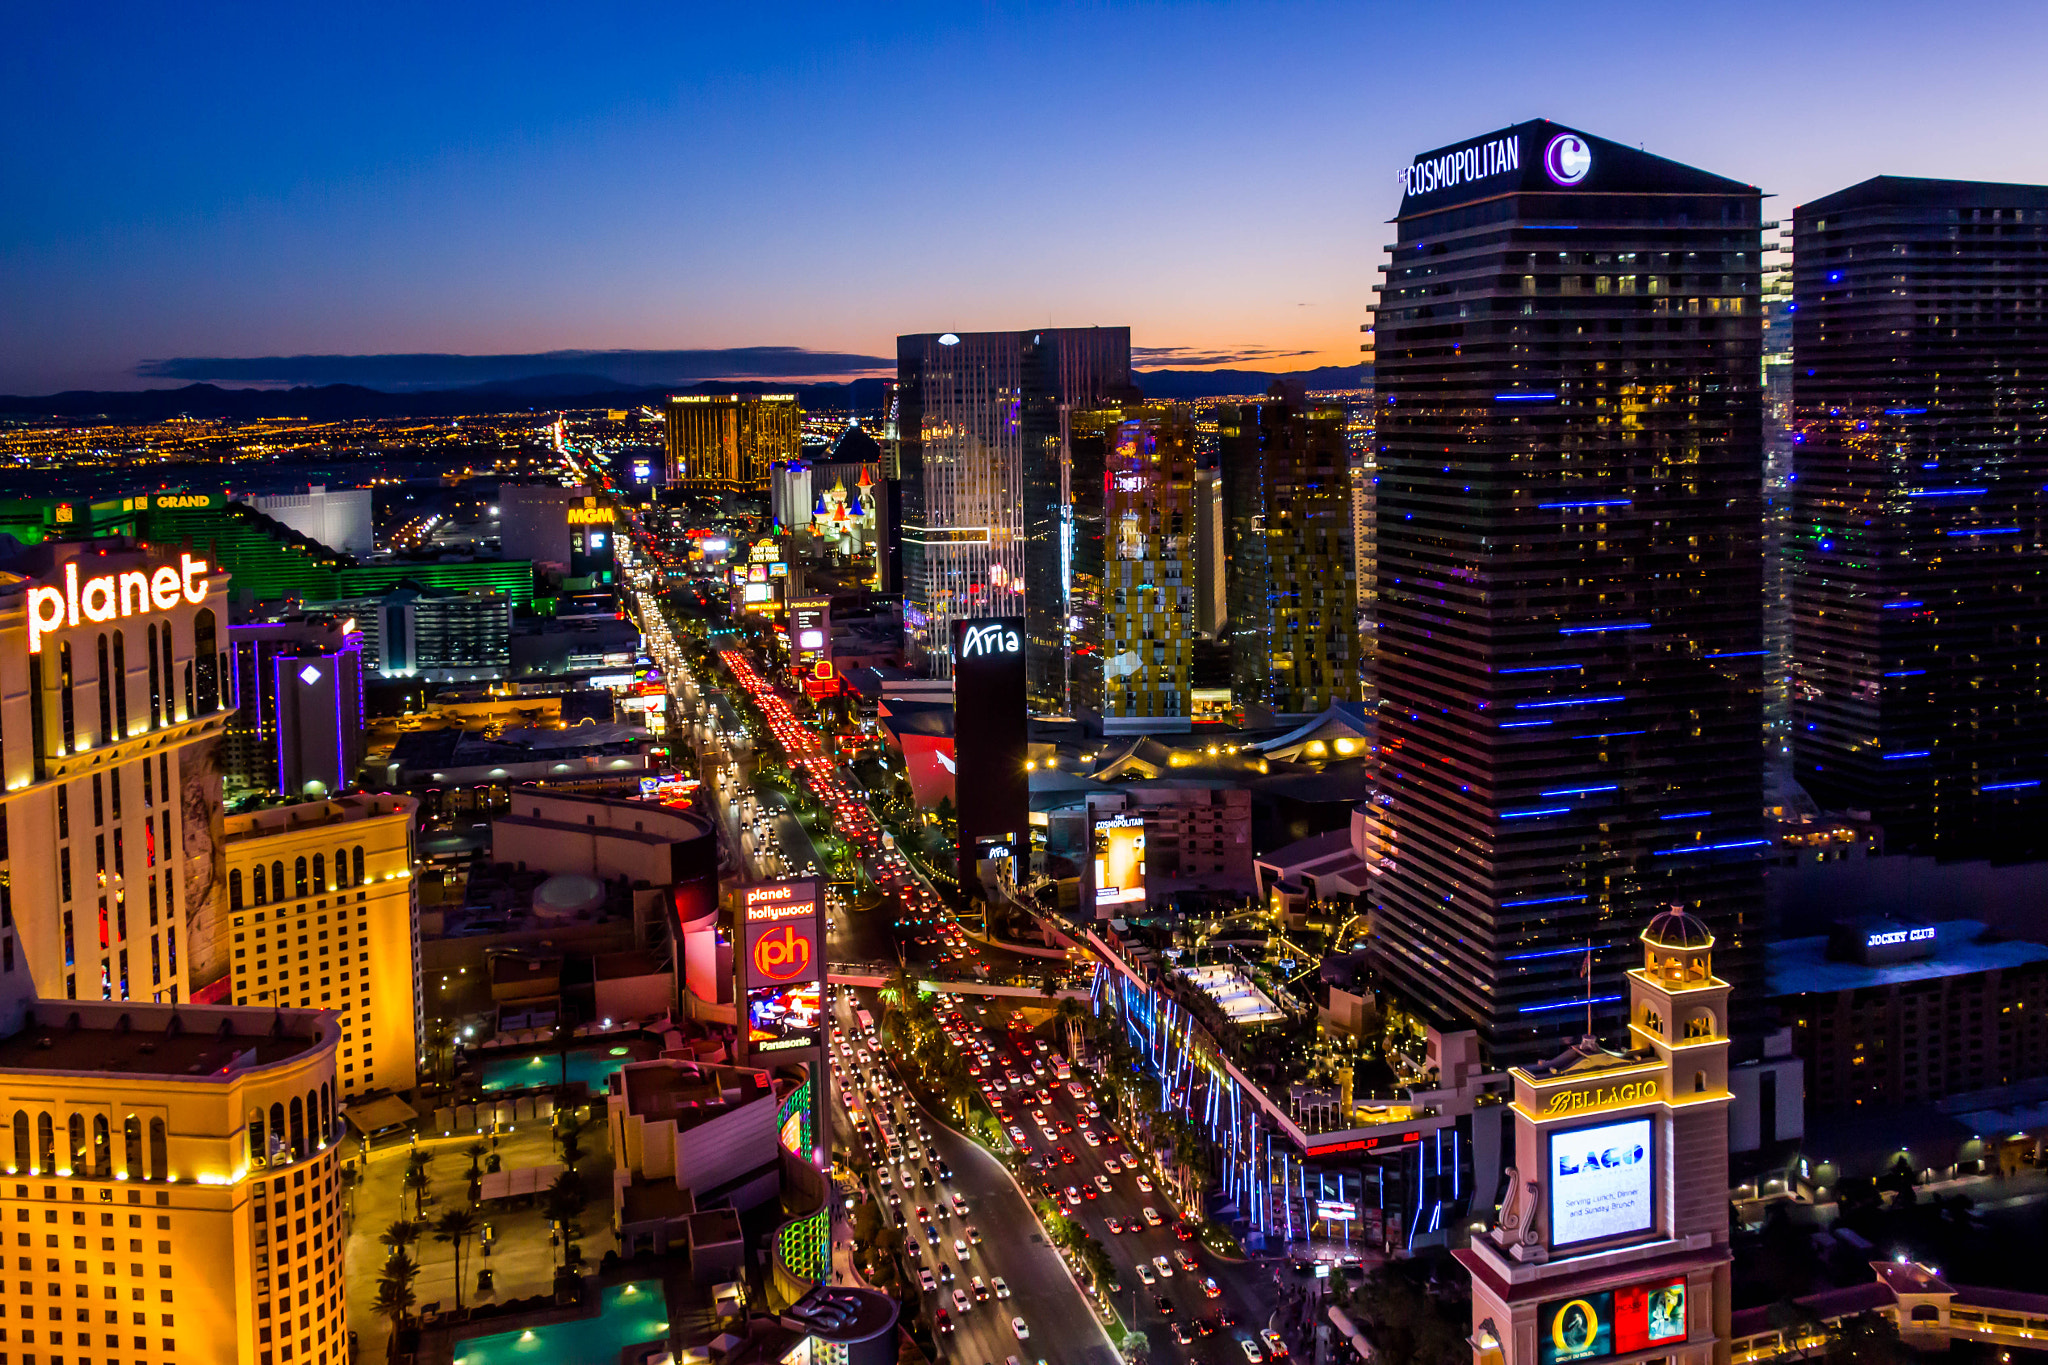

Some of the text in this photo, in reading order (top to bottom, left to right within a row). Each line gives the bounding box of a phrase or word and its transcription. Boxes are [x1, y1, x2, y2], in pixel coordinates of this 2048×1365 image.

[1407, 135, 1519, 197] COSMOPOLITAN
[157, 495, 210, 508] GRAND
[568, 507, 614, 524] MGM
[27, 553, 209, 654] planet
[963, 624, 1019, 658] Aria
[1096, 817, 1144, 830] COSMOPOLITAN
[989, 846, 1009, 859] Aria
[747, 887, 791, 905] planet
[748, 902, 814, 920] hollywood
[1868, 927, 1935, 946] JOCKEY CLUB
[761, 925, 809, 972] ph
[759, 1036, 811, 1051] Panasonic
[1543, 1080, 1657, 1115] BELLAGIO
[1559, 1143, 1644, 1177] LAGO
[1565, 1198, 1591, 1207] Serving
[1617, 1189, 1638, 1198] Dinner
[1570, 1200, 1635, 1217] and Sunday Brunch
